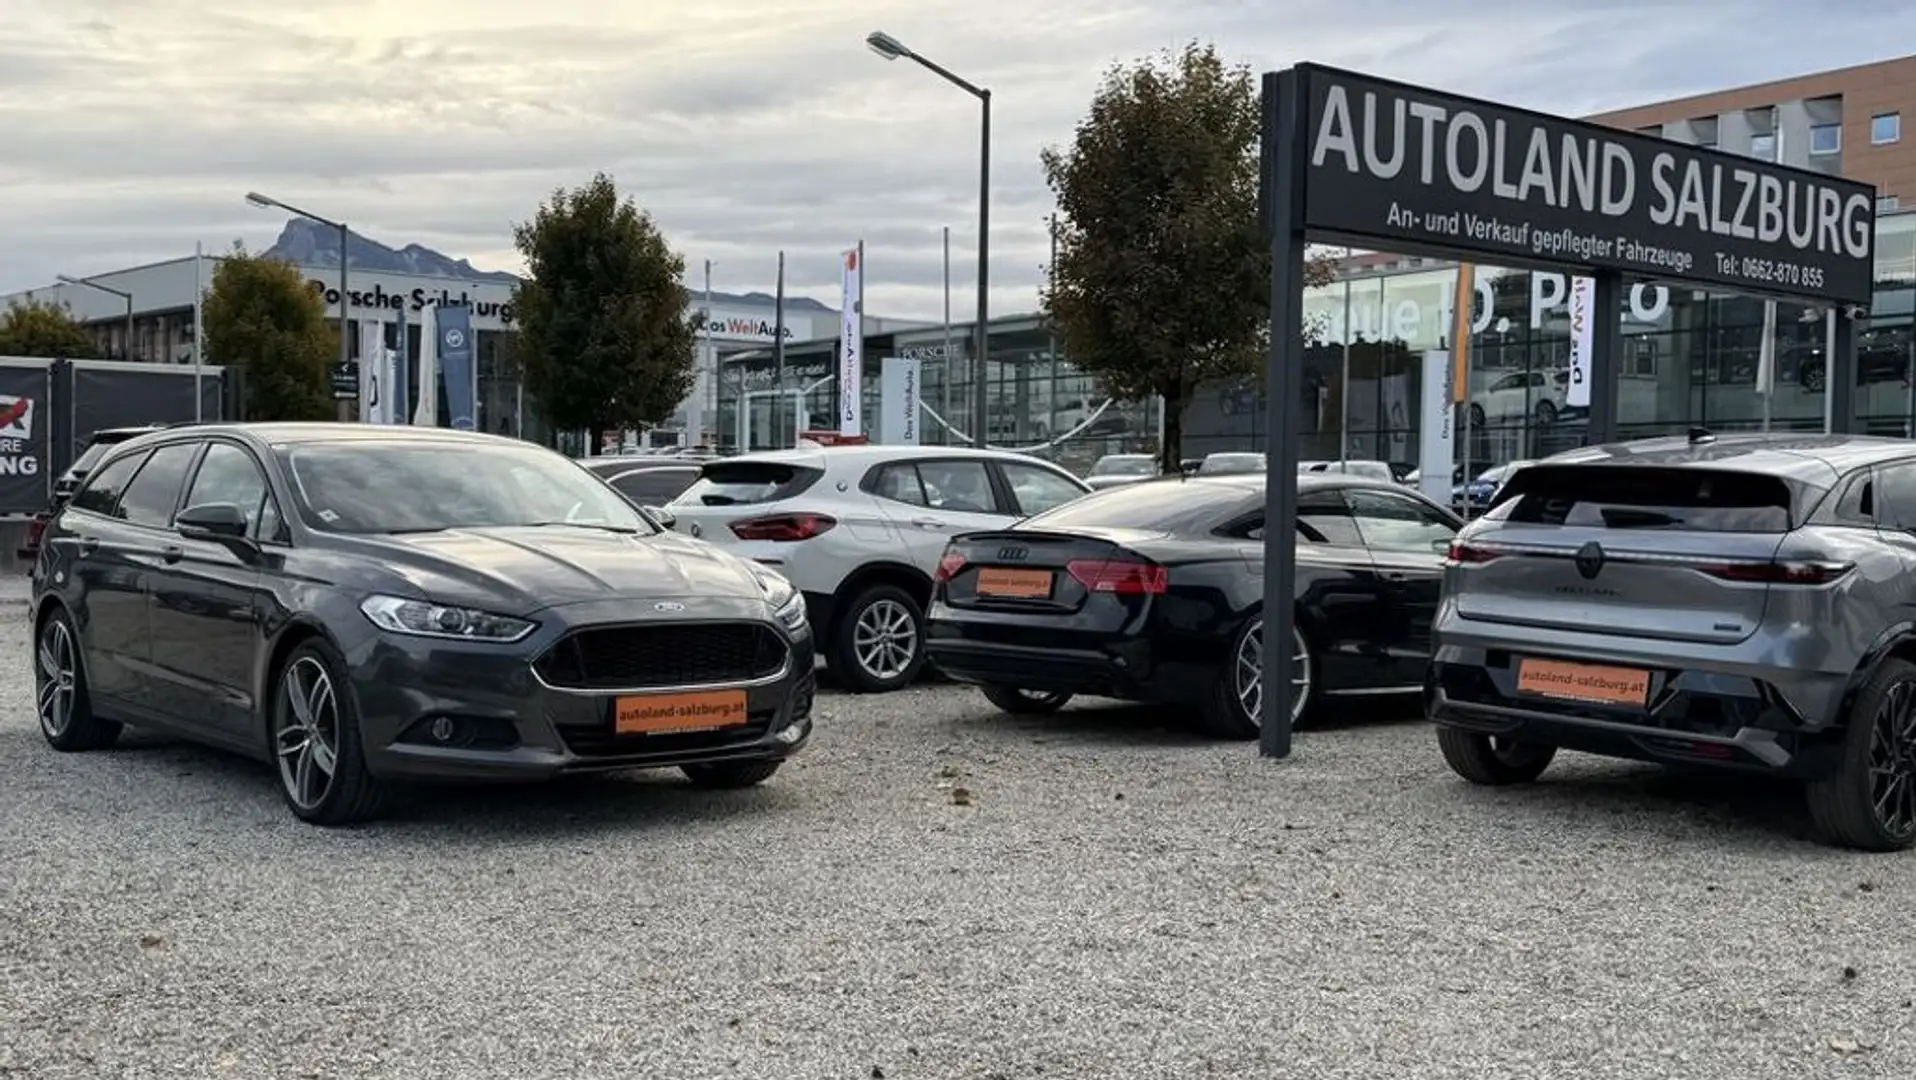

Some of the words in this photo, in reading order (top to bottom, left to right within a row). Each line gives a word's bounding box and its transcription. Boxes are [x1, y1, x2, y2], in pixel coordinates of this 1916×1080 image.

[1312, 85, 1635, 216] AUTOLAND
[1649, 153, 1870, 258] SALZBURG
[1387, 202, 1420, 226] An-
[1424, 212, 1459, 235] und
[1464, 213, 1528, 245] Verkauf
[1532, 228, 1612, 260] gepflegter
[1616, 237, 1693, 272] Fahrzeuge
[1715, 252, 1740, 275] Tel:
[1742, 258, 1799, 285] 0662-870
[1801, 267, 1824, 288] 855
[308, 279, 404, 310] Posche
[1530, 270, 1669, 329] Po
[727, 318, 794, 339] WeltAuo.
[1522, 671, 1645, 694] autoland-salzburg.at
[619, 702, 744, 721] autoland-salzburg.at
